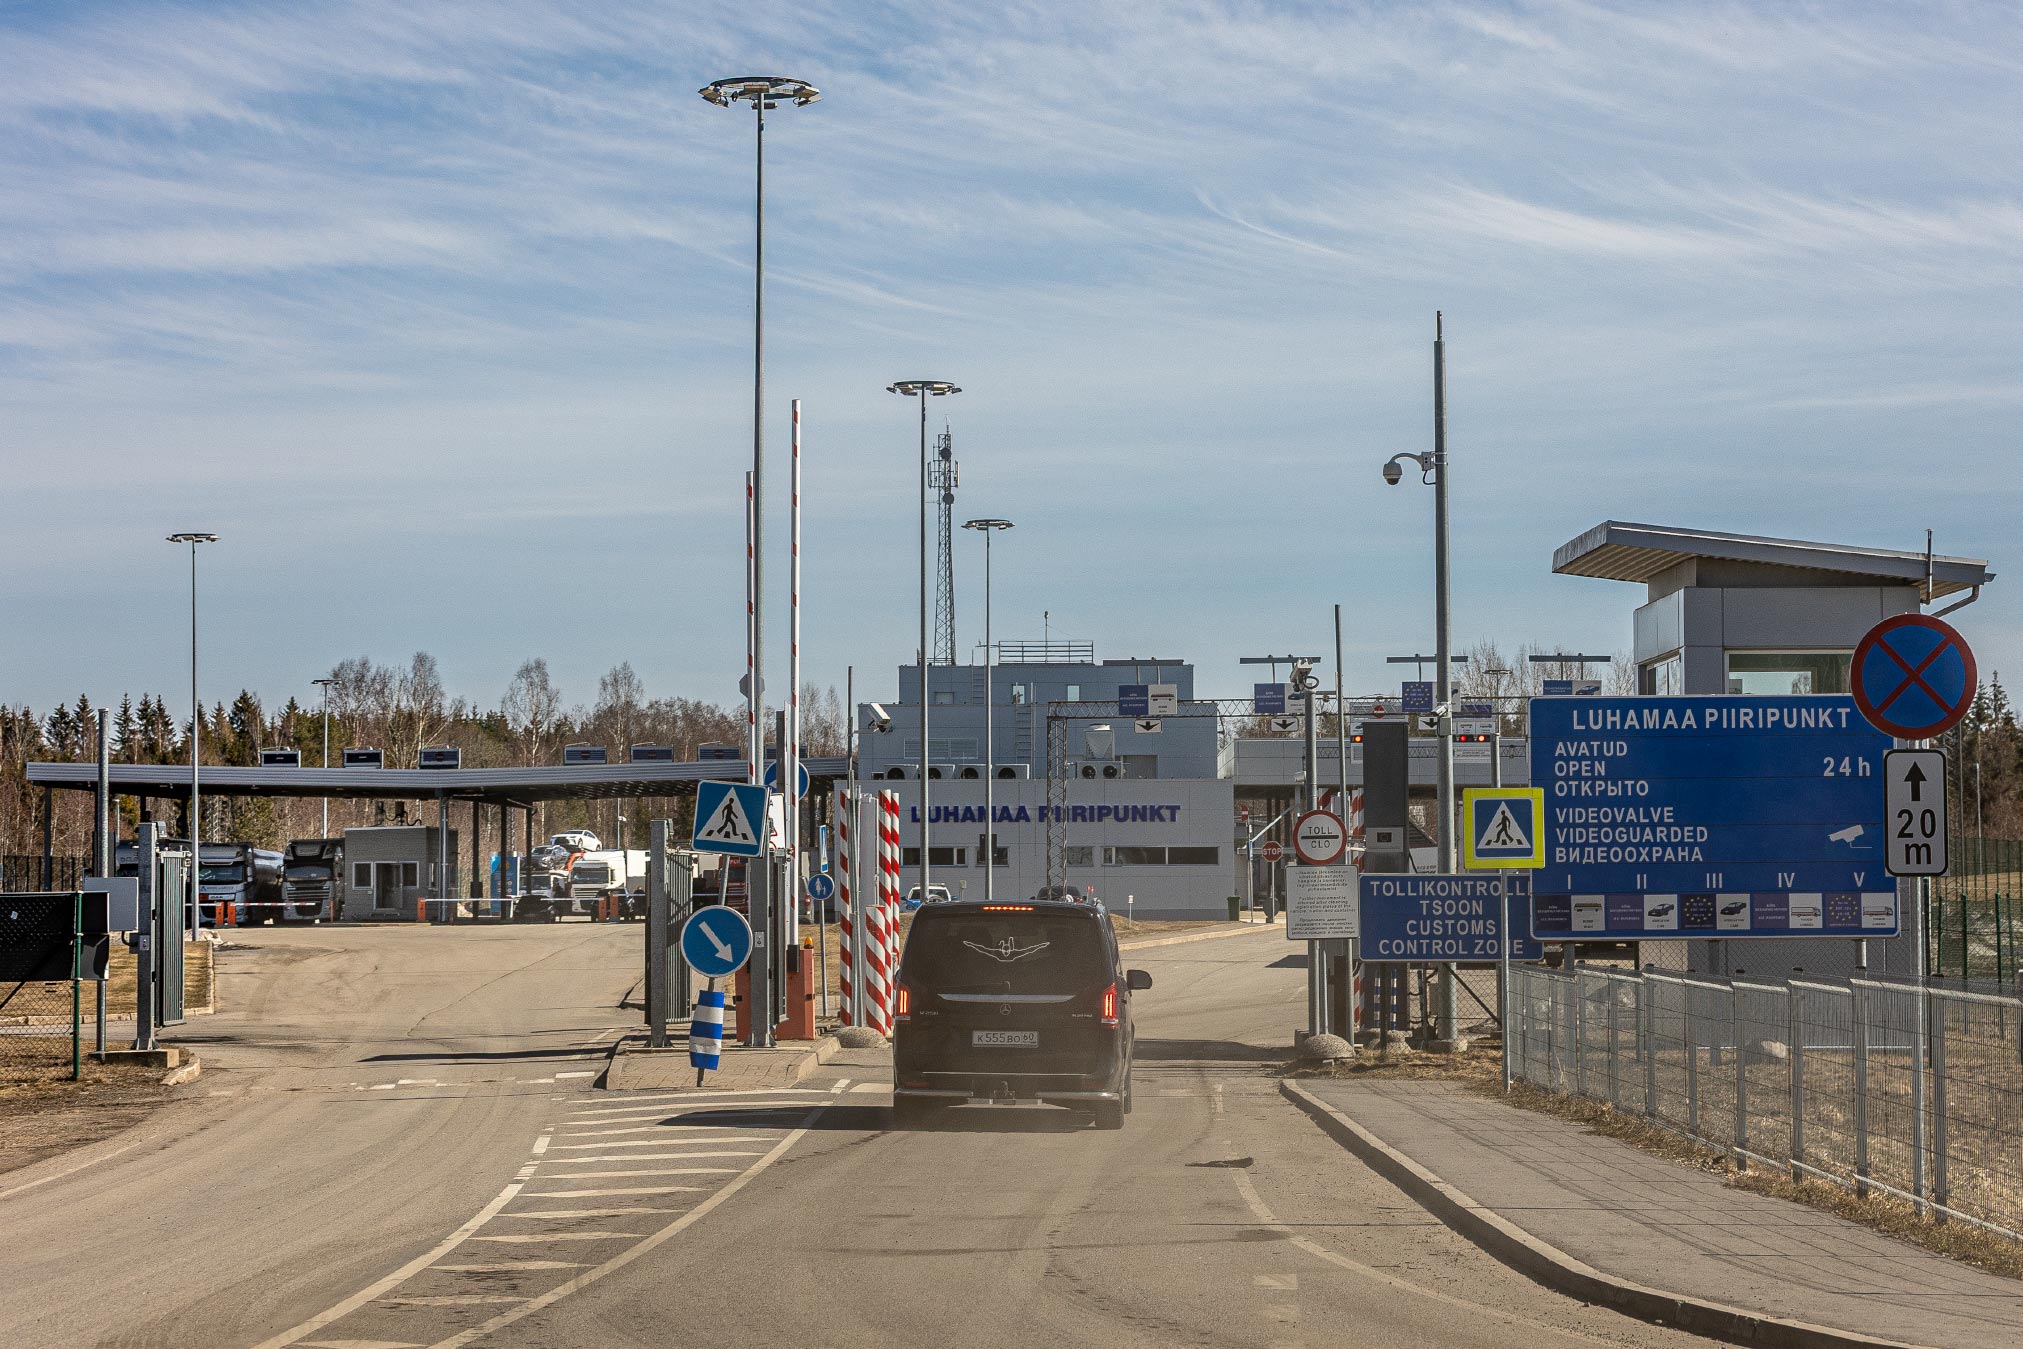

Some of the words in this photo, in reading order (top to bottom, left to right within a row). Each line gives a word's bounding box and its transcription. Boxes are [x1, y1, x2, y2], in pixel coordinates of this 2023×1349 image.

[1573, 708, 1698, 730] LUHAMAA
[1705, 706, 1851, 730] PIIRIPUNKT
[1554, 741, 1628, 757] AVATUD
[1554, 760, 1606, 777] OPEN
[1554, 780, 1649, 797] ОТКРЫТО
[1555, 806, 1674, 824] VIDEOVALVE
[1896, 808, 1937, 839] 20
[1307, 826, 1333, 836] TOLL
[1555, 826, 1708, 843] VIDEOGUARDED
[1262, 847, 1282, 856] STOP
[1310, 839, 1331, 849] CLO
[1555, 846, 1703, 864] ВИДЕООХРАНА
[1904, 842, 1932, 865] m
[1635, 873, 1648, 890] II
[1705, 872, 1724, 889] III
[1777, 872, 1796, 888] IV
[1853, 871, 1866, 887] V
[1419, 899, 1484, 916] TSOON
[1406, 919, 1497, 936] CUSTOMS
[1378, 939, 1469, 955] CONTROL
